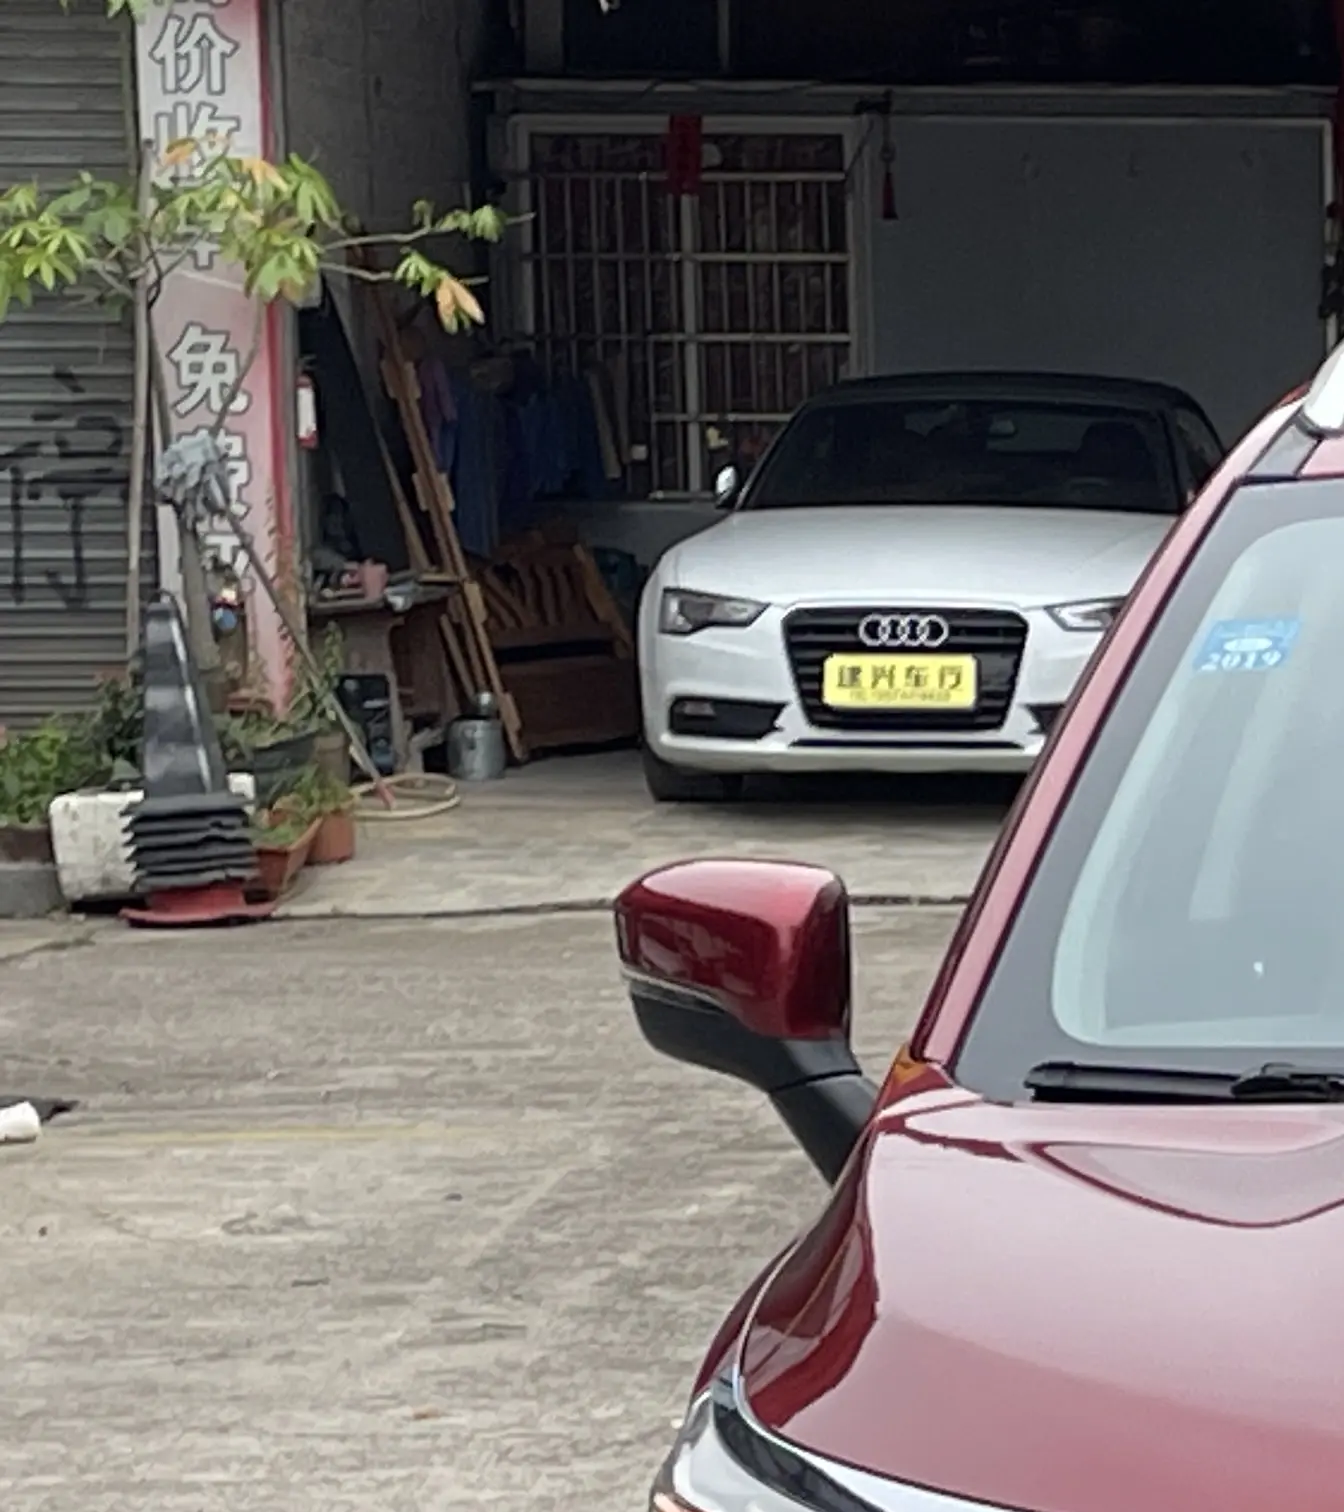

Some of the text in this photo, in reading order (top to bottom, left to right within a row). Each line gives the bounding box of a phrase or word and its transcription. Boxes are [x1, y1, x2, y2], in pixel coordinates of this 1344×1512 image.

[1200, 651, 1282, 671] 2019
[837, 664, 964, 690] 建兴车行
